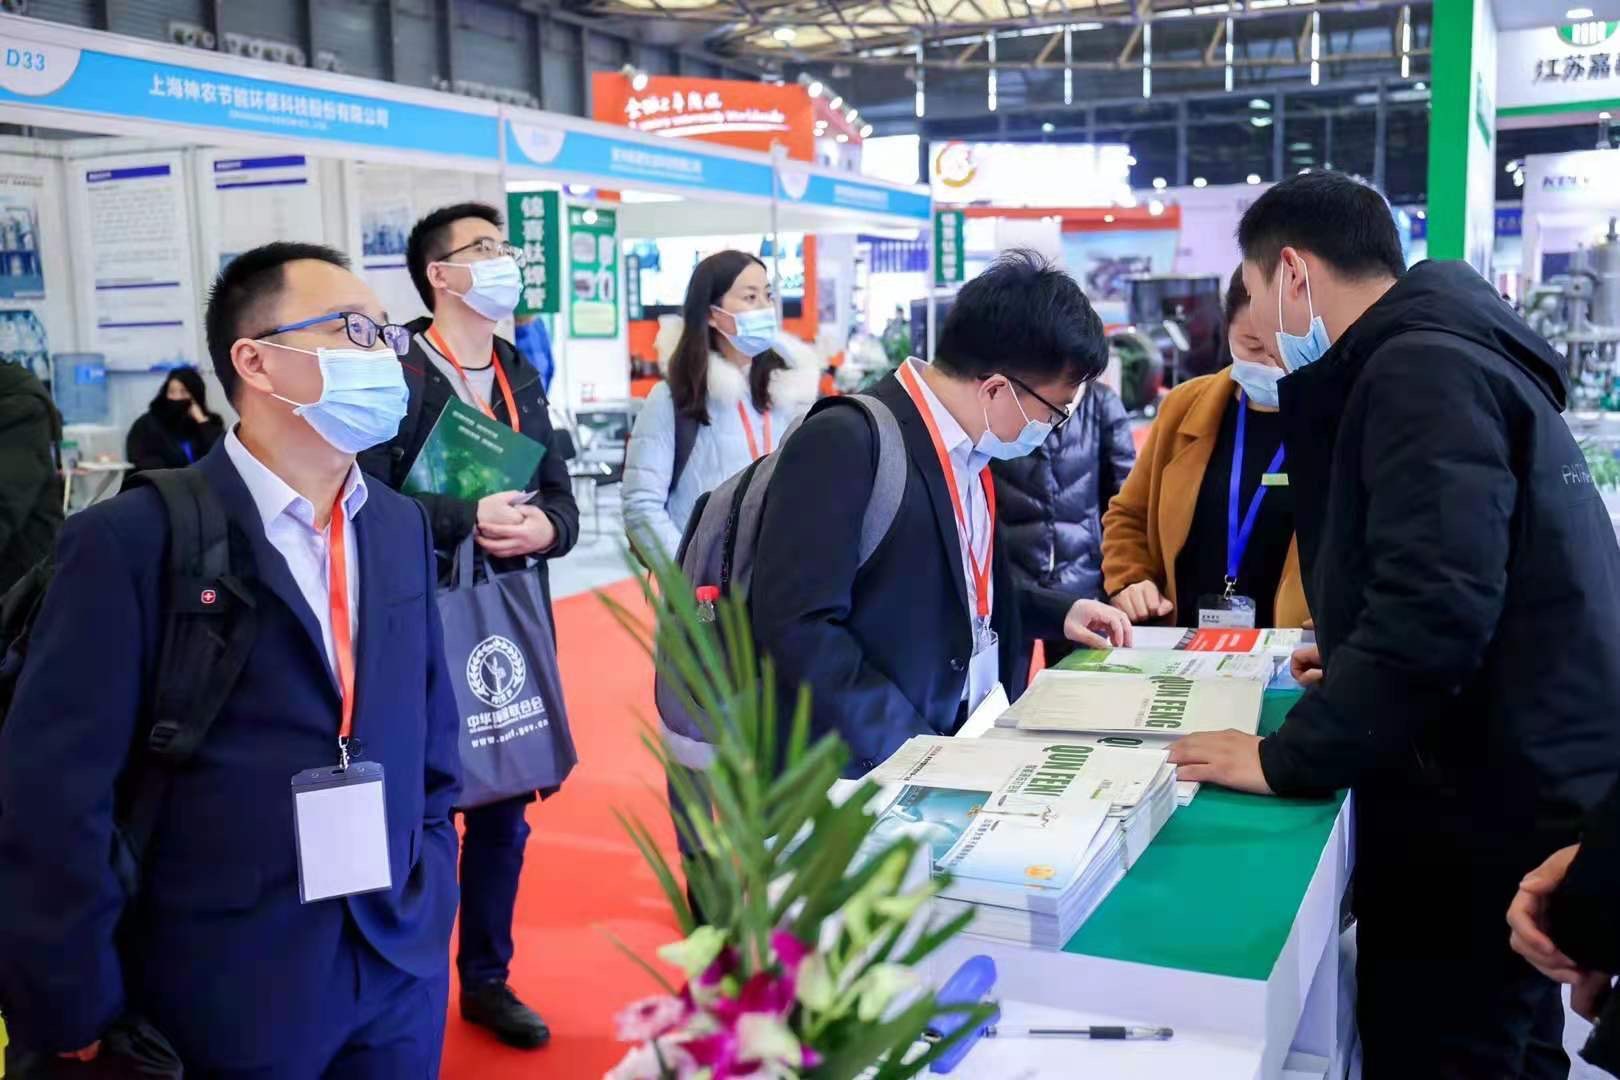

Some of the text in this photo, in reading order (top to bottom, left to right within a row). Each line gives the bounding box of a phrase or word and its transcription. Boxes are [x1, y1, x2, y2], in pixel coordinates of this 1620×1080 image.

[6, 48, 45, 71] D33
[1148, 675, 1195, 698] QUN
[1145, 699, 1187, 729] FENG
[1042, 744, 1095, 771] QUN
